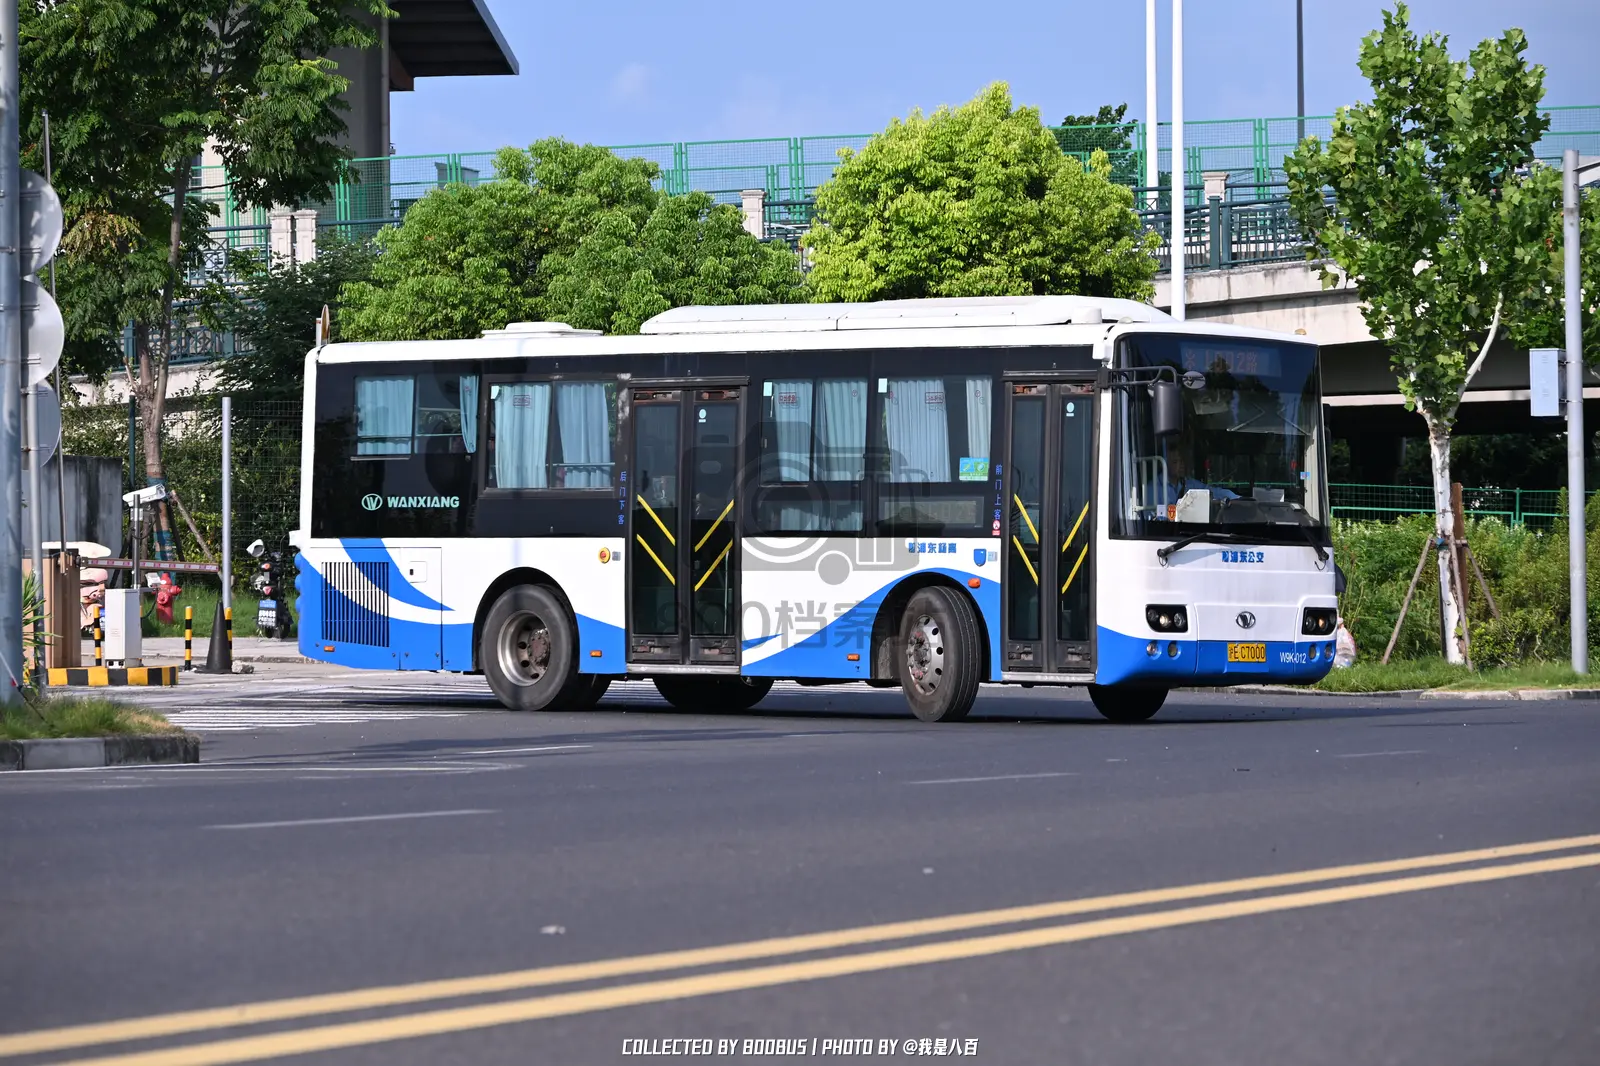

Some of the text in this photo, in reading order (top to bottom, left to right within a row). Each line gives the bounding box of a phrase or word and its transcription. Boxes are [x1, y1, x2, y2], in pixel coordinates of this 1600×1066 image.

[618, 471, 628, 524] 后门下客
[994, 464, 1003, 520] 前门上客
[387, 496, 460, 508] WANXIANG
[1230, 550, 1264, 563] 浦东公交
[1280, 652, 1307, 664] W9K-012
